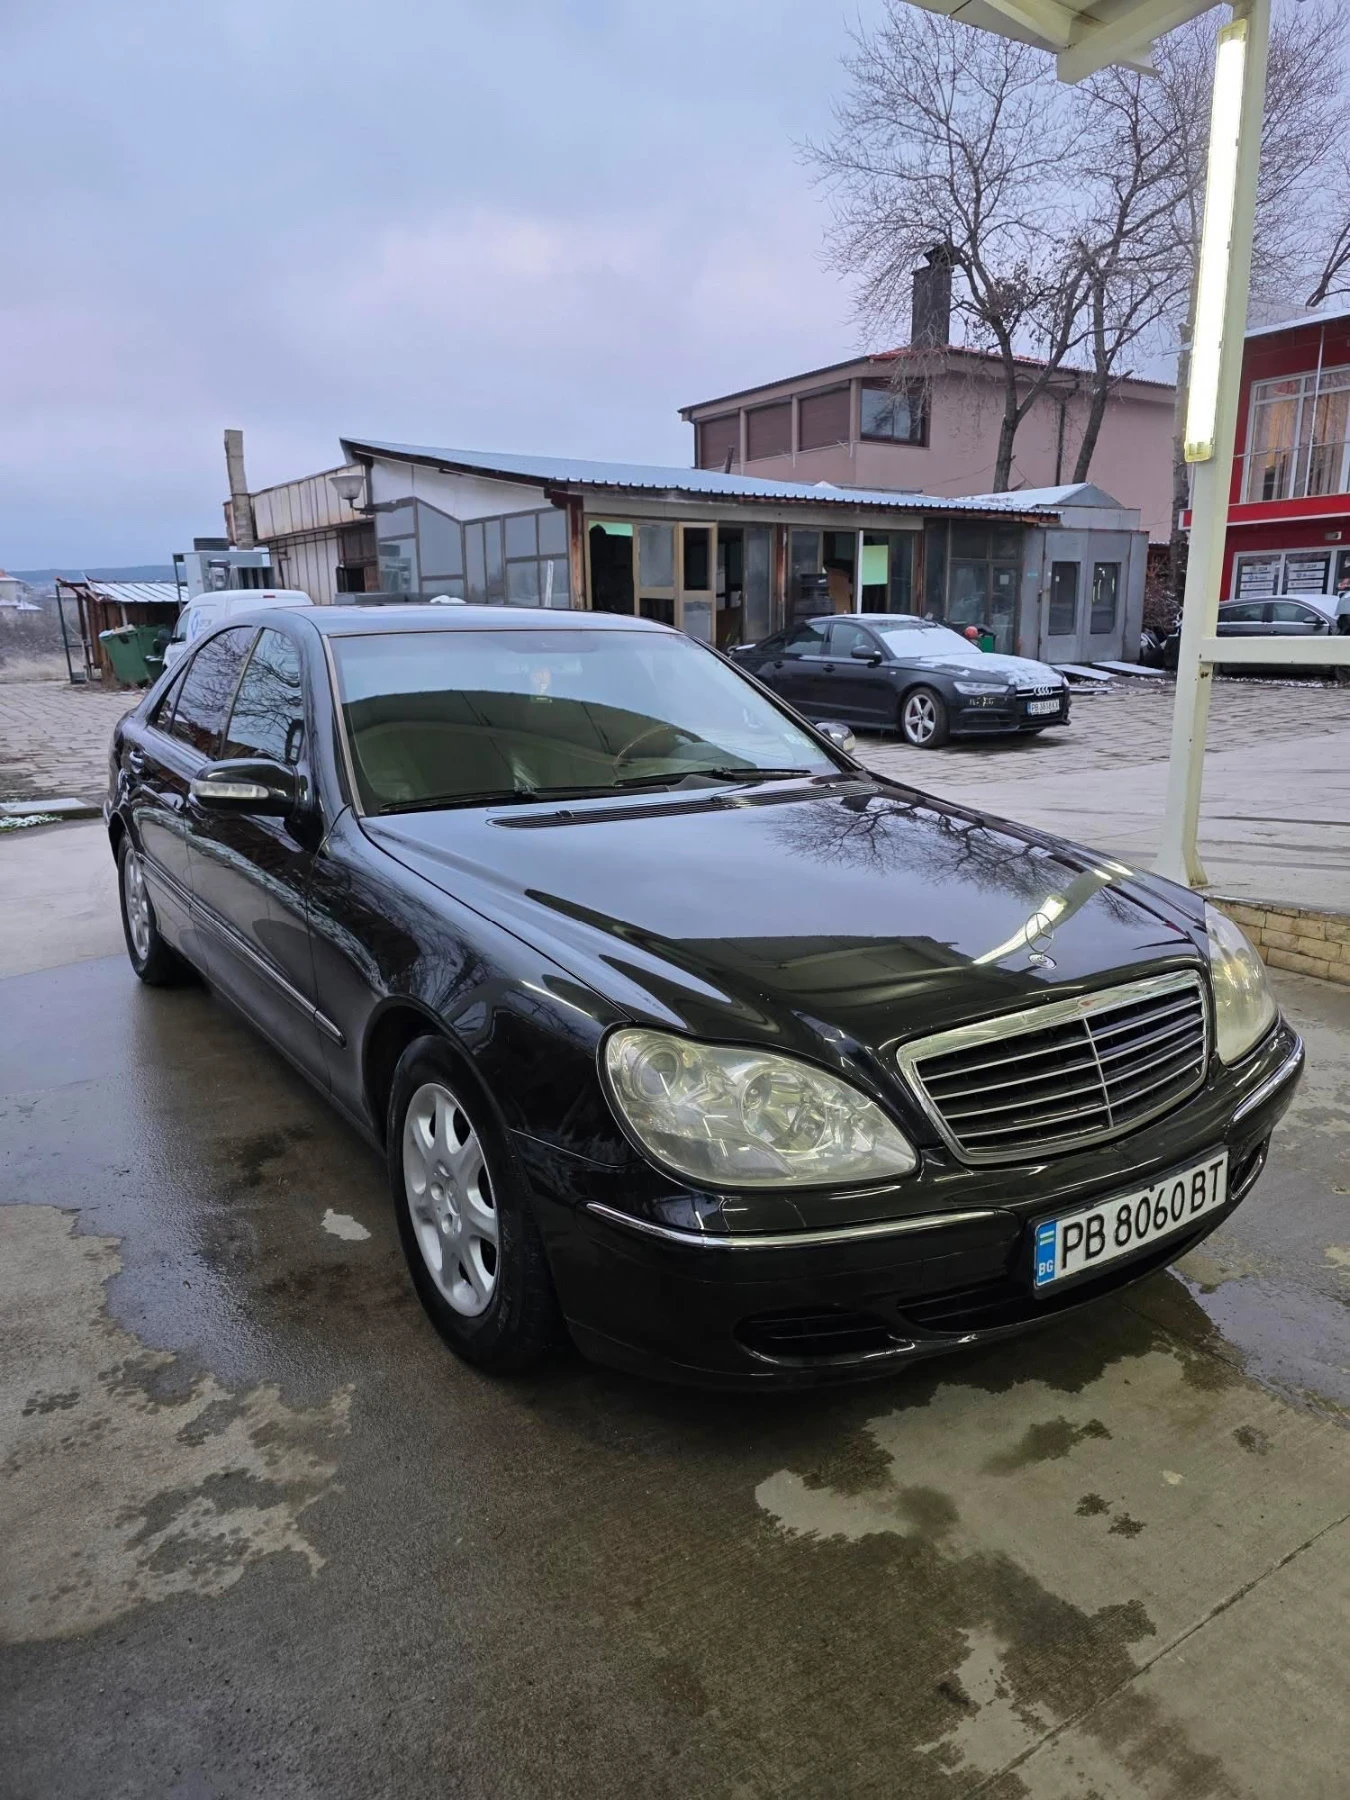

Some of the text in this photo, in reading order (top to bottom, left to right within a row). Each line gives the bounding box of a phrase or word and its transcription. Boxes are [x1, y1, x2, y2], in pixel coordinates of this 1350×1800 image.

[1060, 1159, 1224, 1269] PB 8060 BT
[1038, 1261, 1054, 1277] BG
